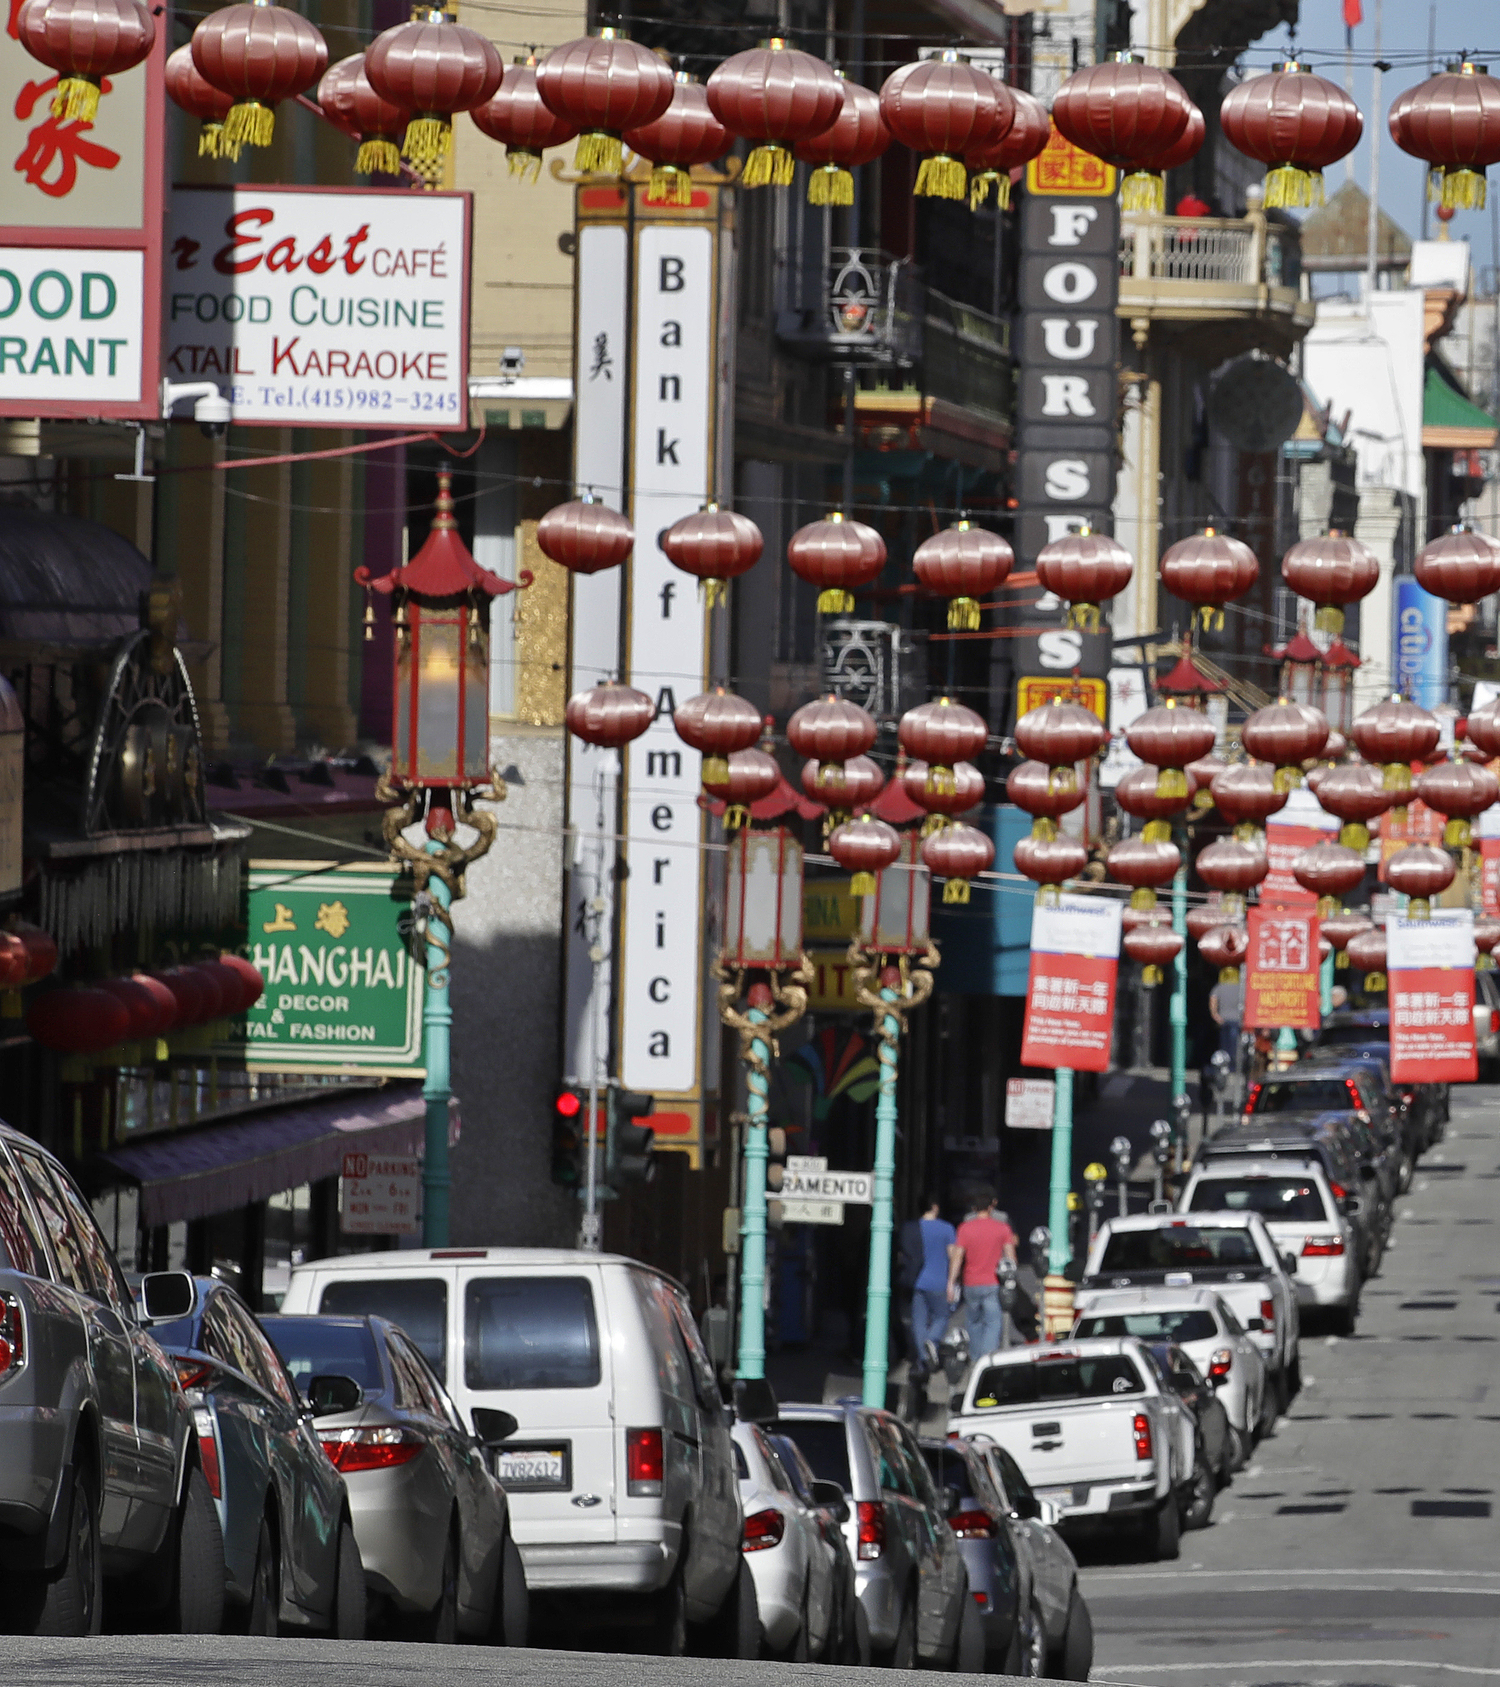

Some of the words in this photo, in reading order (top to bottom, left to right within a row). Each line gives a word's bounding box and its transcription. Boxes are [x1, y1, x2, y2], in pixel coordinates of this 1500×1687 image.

[213, 208, 371, 276] East
[372, 242, 449, 279] CAFÉ
[170, 293, 273, 323] FOOD
[1041, 205, 1098, 418] FOUR
[271, 335, 449, 381] KARAOKE
[589, 331, 613, 382] 美
[656, 256, 686, 467] Bank
[646, 686, 683, 1058] America
[262, 901, 350, 939] 上海
[278, 994, 350, 1012] DECOR
[290, 1022, 376, 1041] FASHION
[345, 1156, 366, 1176] NO
[369, 1160, 416, 1177] PARKING
